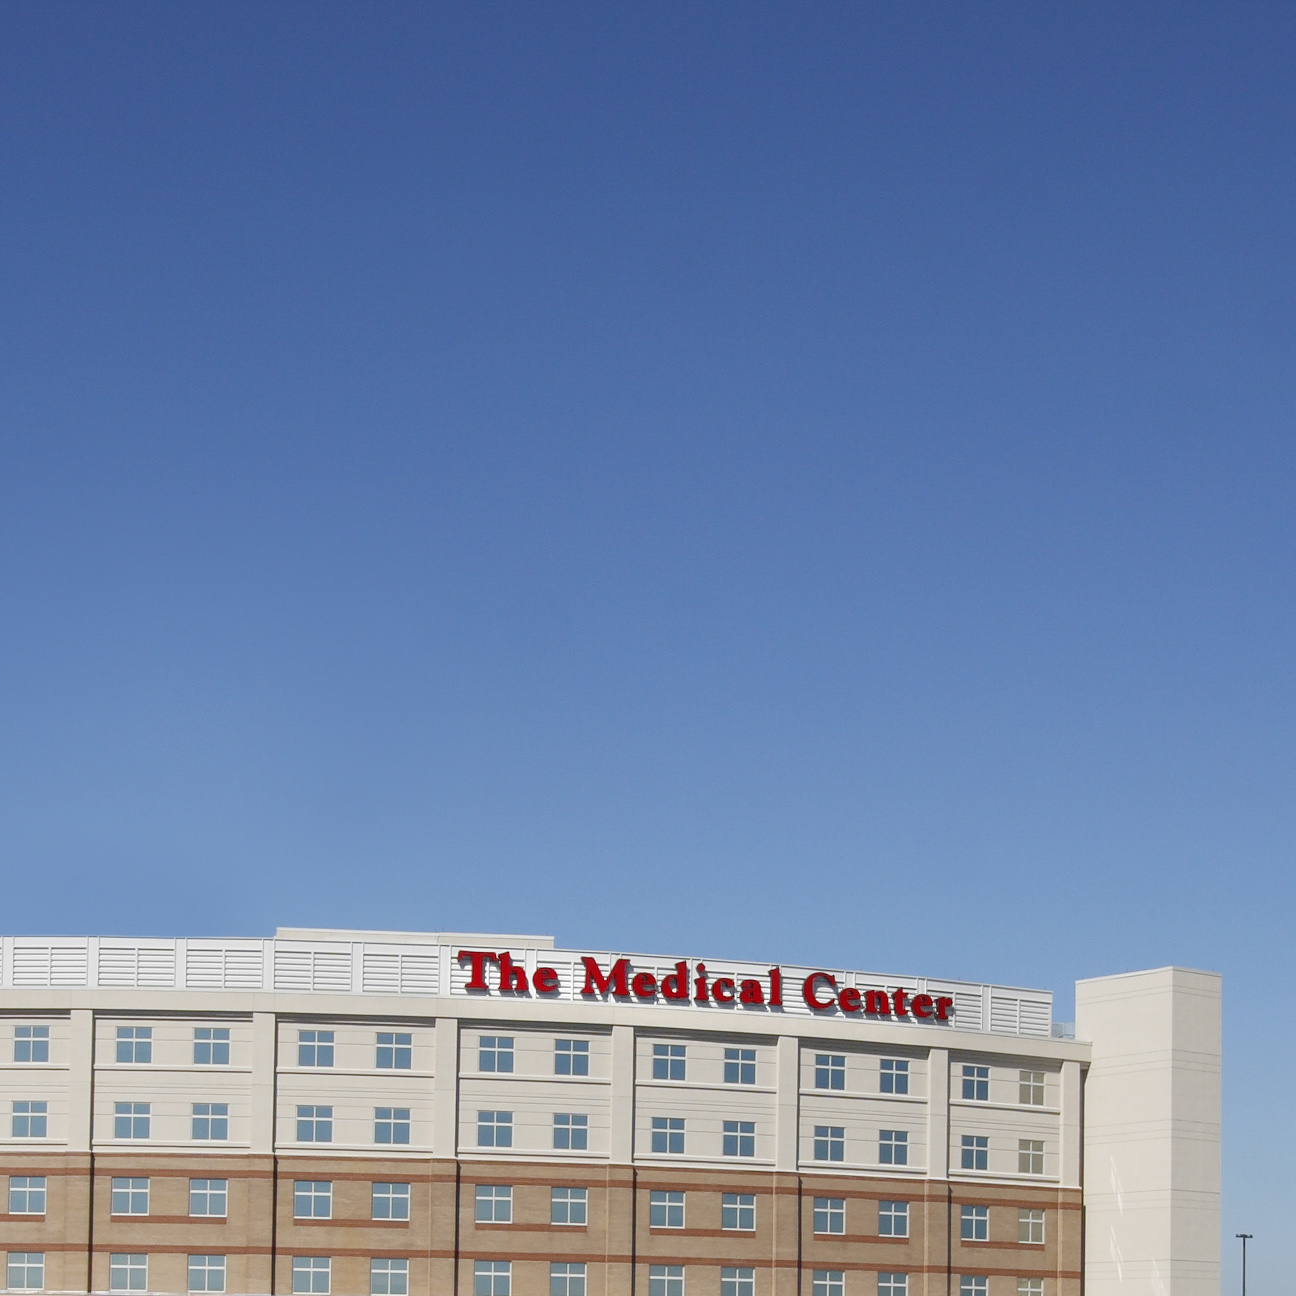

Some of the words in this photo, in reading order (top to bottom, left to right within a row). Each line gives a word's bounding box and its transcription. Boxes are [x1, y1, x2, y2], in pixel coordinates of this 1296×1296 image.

[457, 950, 558, 993] The
[580, 956, 782, 1006] Medical
[803, 972, 953, 1020] Center
